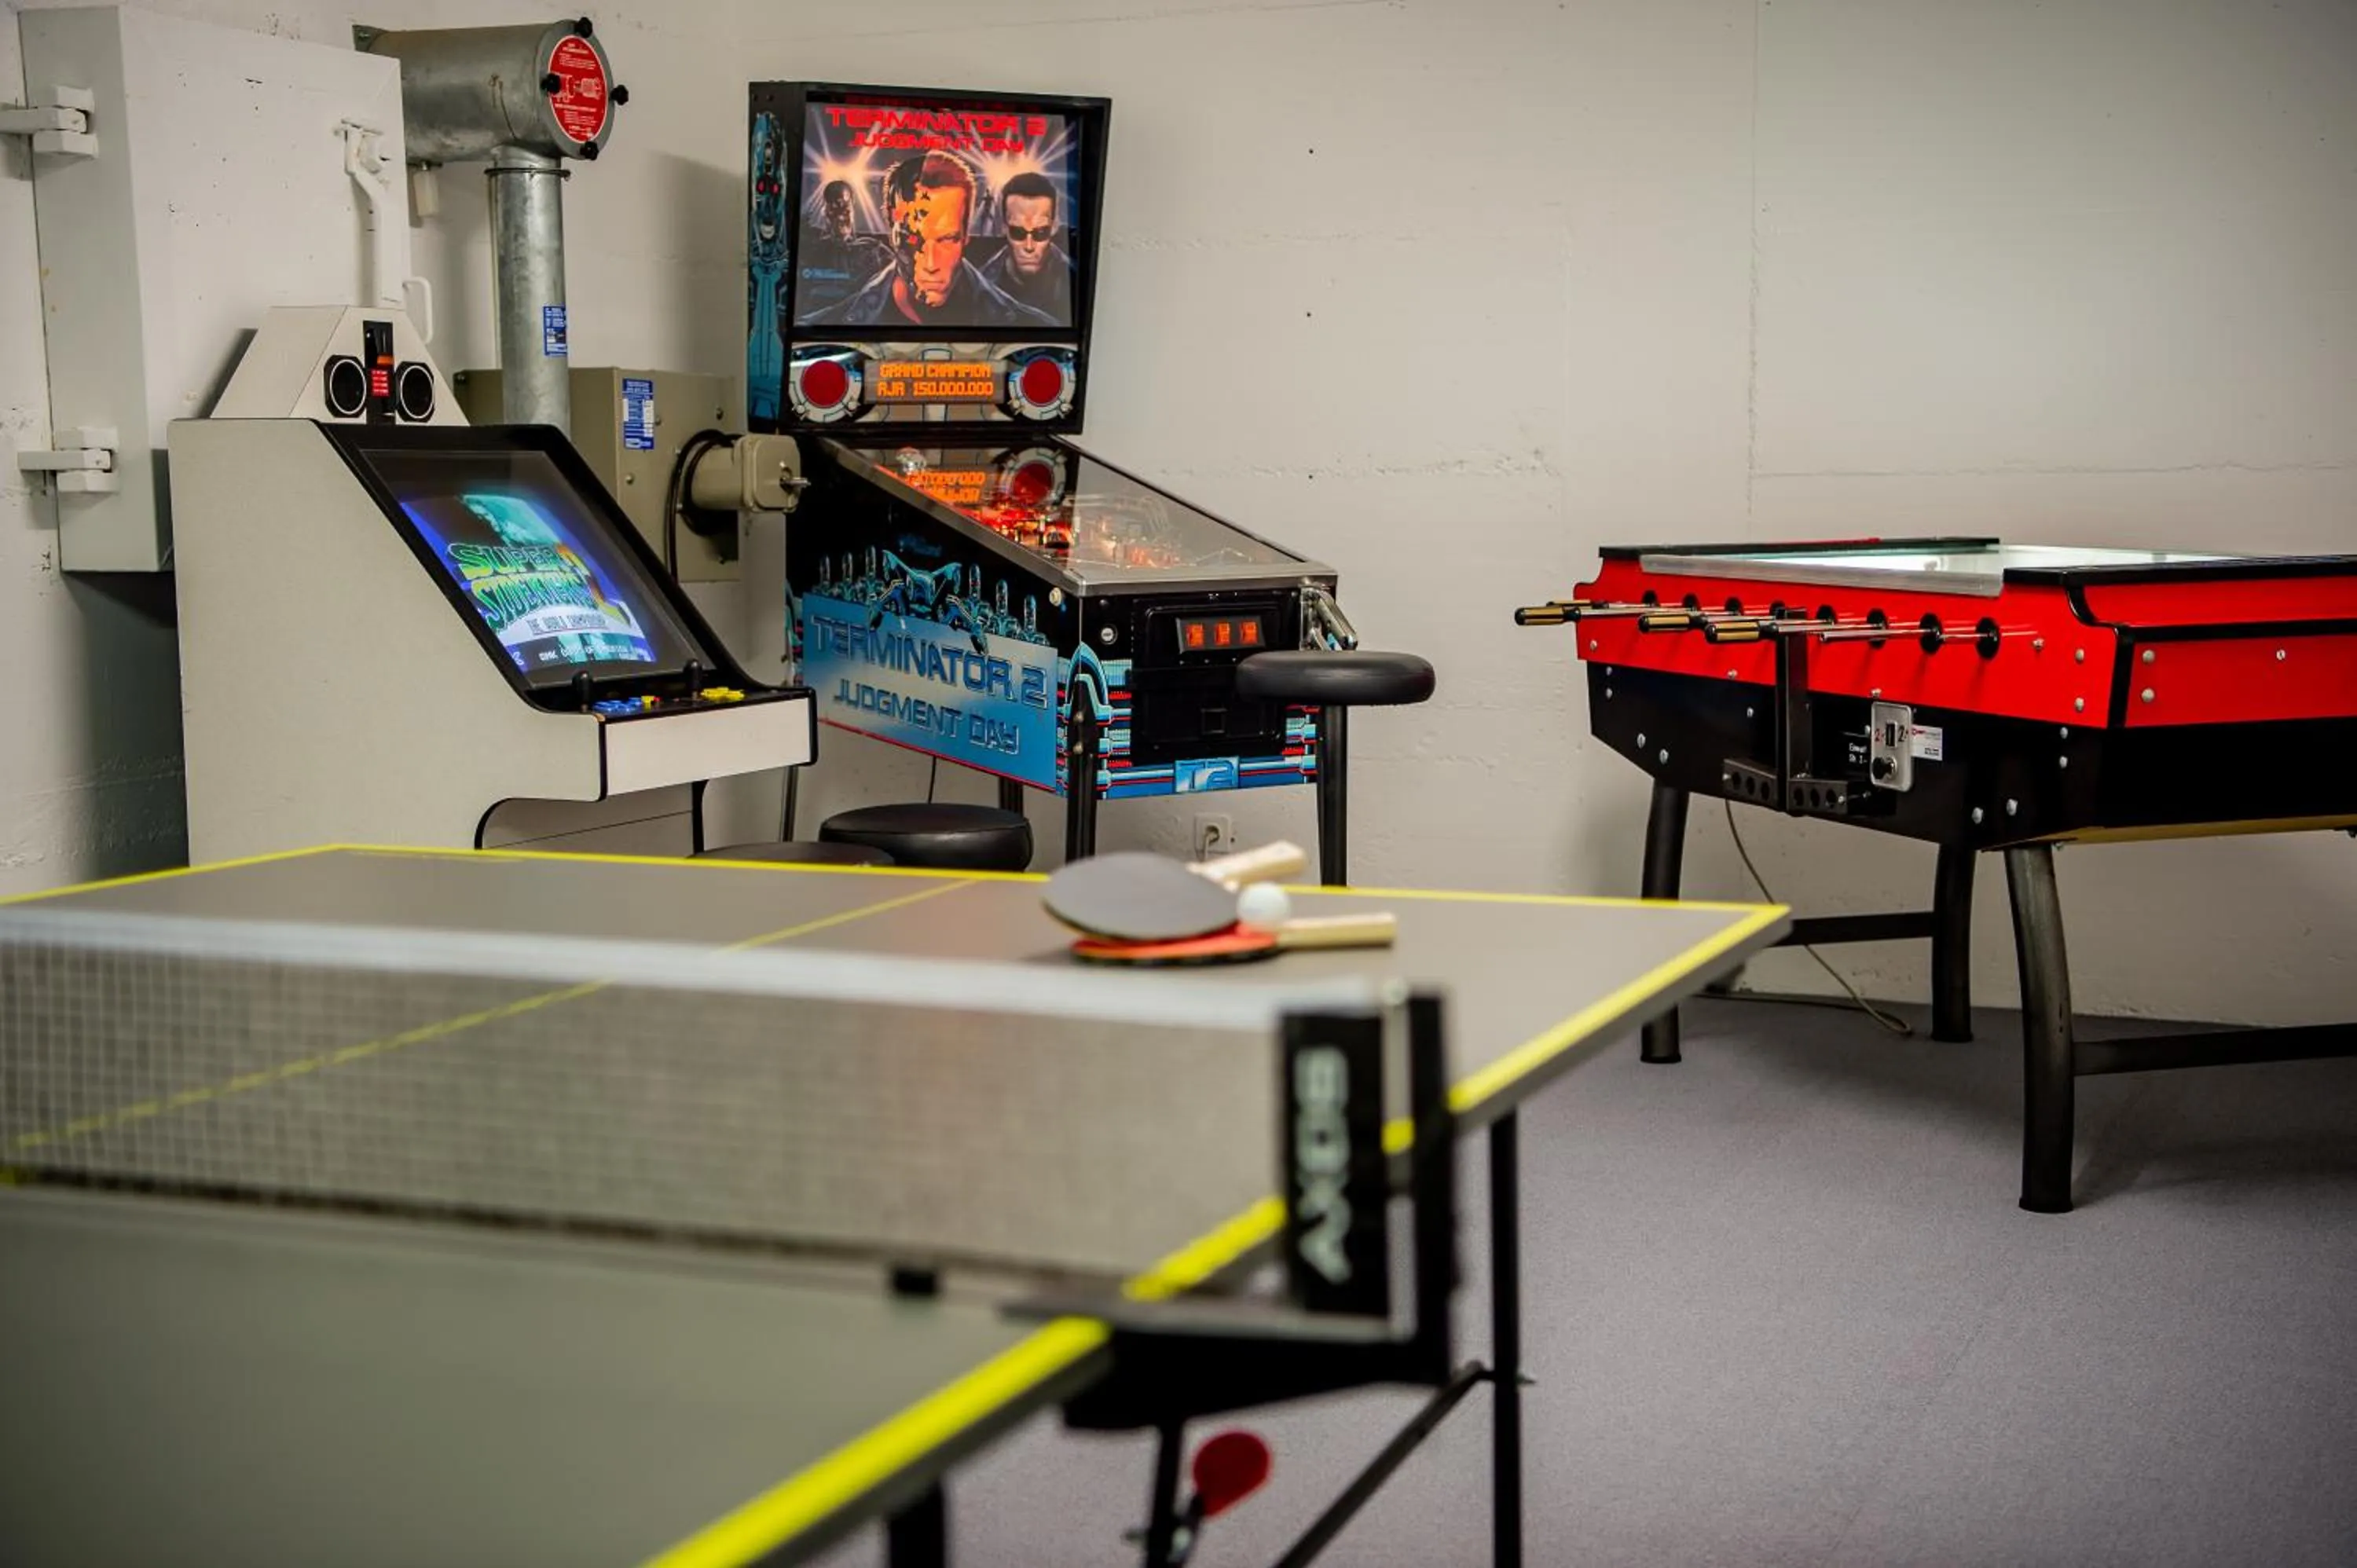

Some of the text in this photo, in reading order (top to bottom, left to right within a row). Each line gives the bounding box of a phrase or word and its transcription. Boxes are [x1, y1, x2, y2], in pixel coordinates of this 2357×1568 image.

[827, 107, 1047, 137] TERMINATOR 2
[849, 131, 1025, 152] JUDGMENT DAY
[879, 364, 992, 378] GRAND CHAMPION
[448, 543, 567, 581] SUPER
[810, 614, 1049, 710] TERMINATOR 2
[833, 678, 1020, 756] JUDGMENT DAY
[1177, 759, 1234, 790] T2
